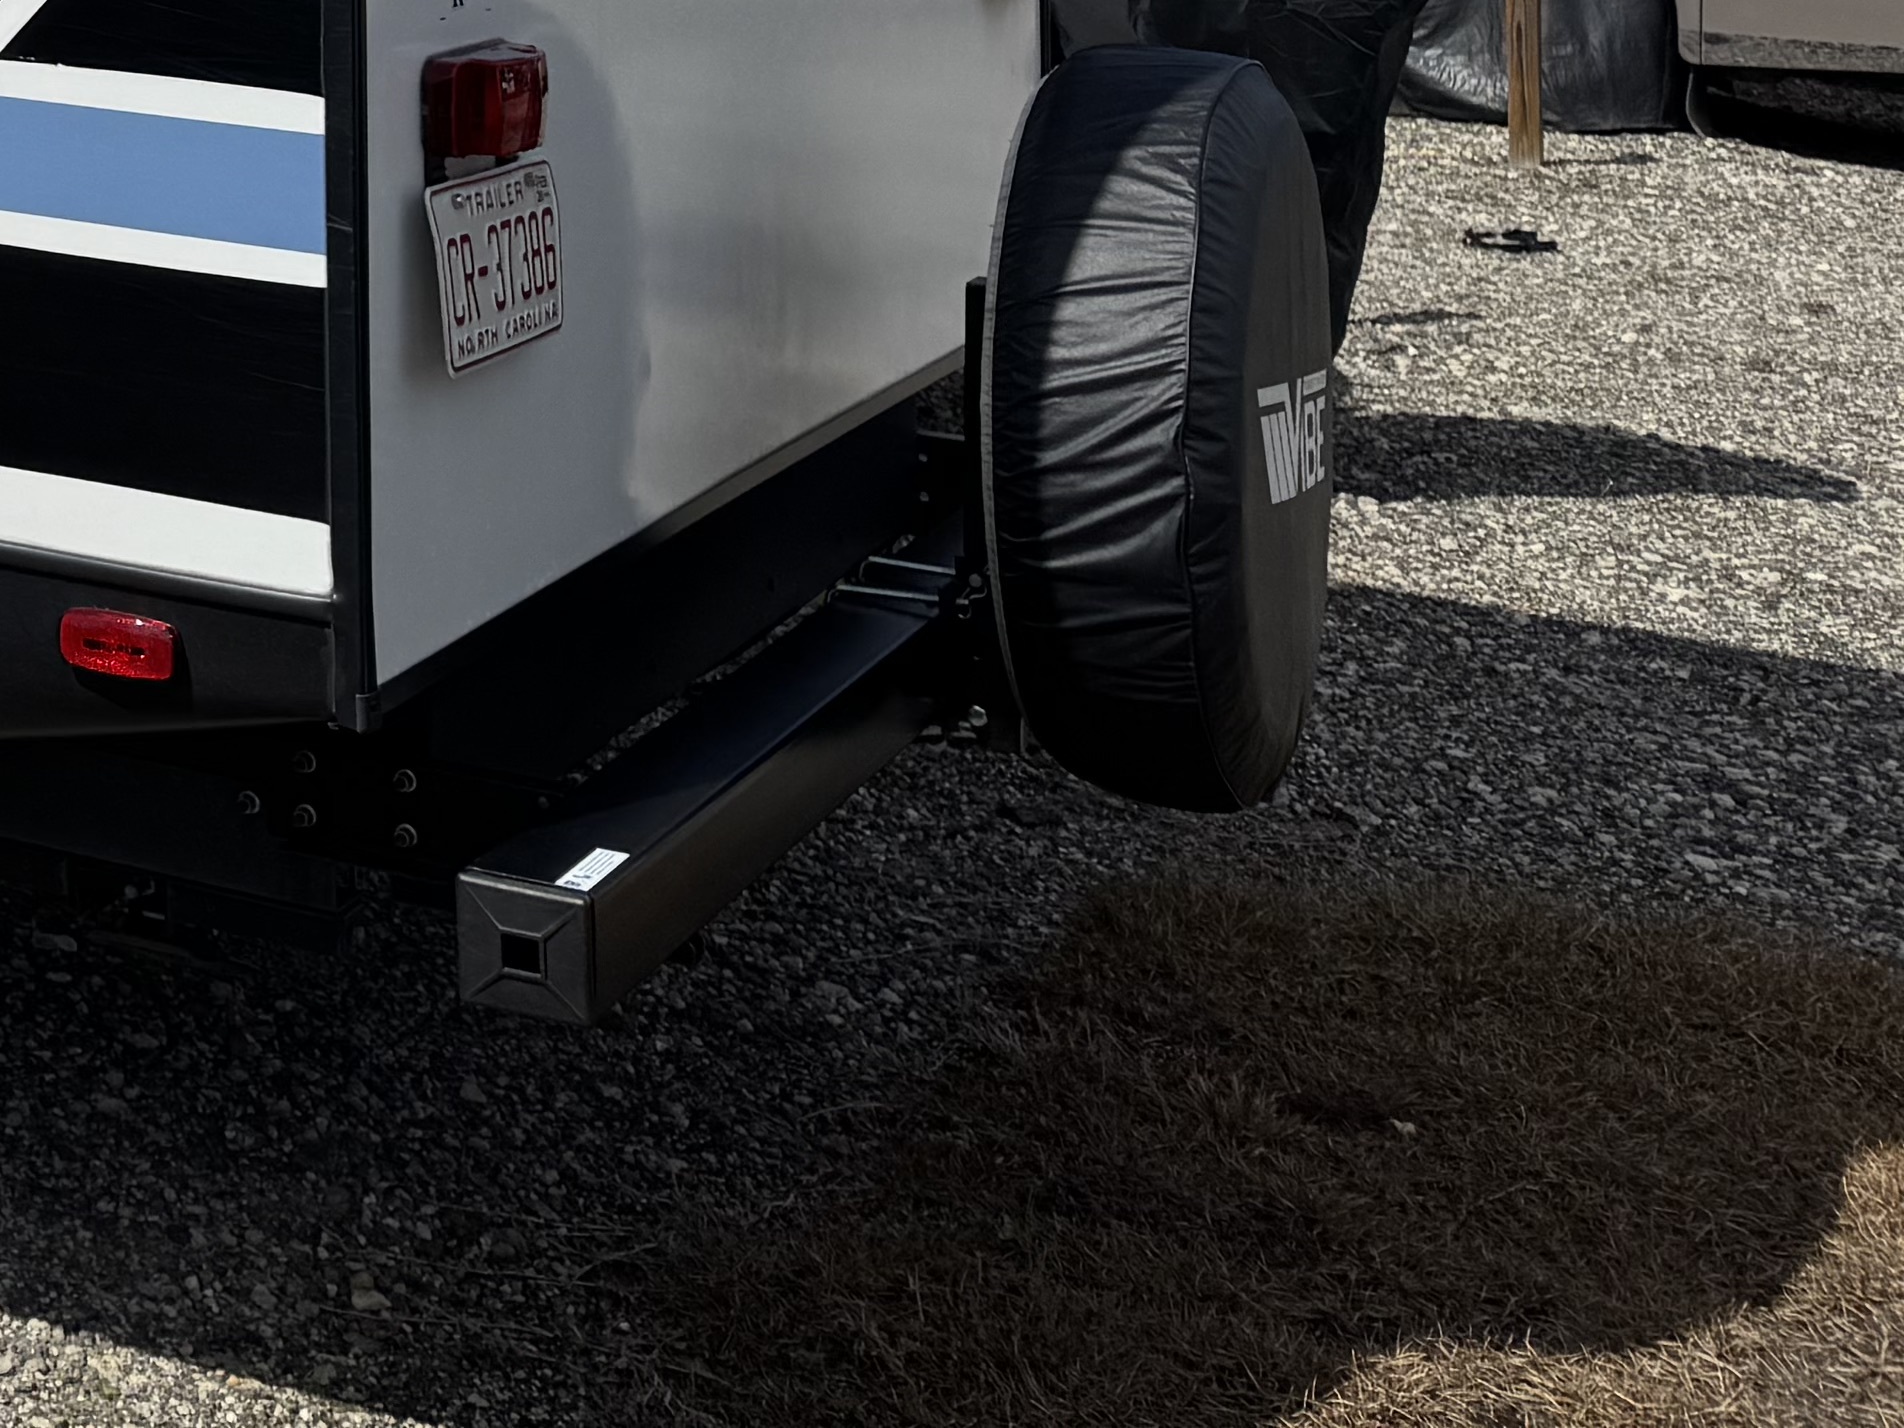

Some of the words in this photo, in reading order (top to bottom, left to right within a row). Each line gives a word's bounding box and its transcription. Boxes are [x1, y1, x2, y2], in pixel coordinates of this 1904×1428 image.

[465, 180, 525, 216] TRAILER
[447, 206, 557, 327] CR-37386
[457, 328, 499, 360] NORTH
[505, 302, 559, 340] CAROLINA
[1257, 377, 1326, 505] VIBE
